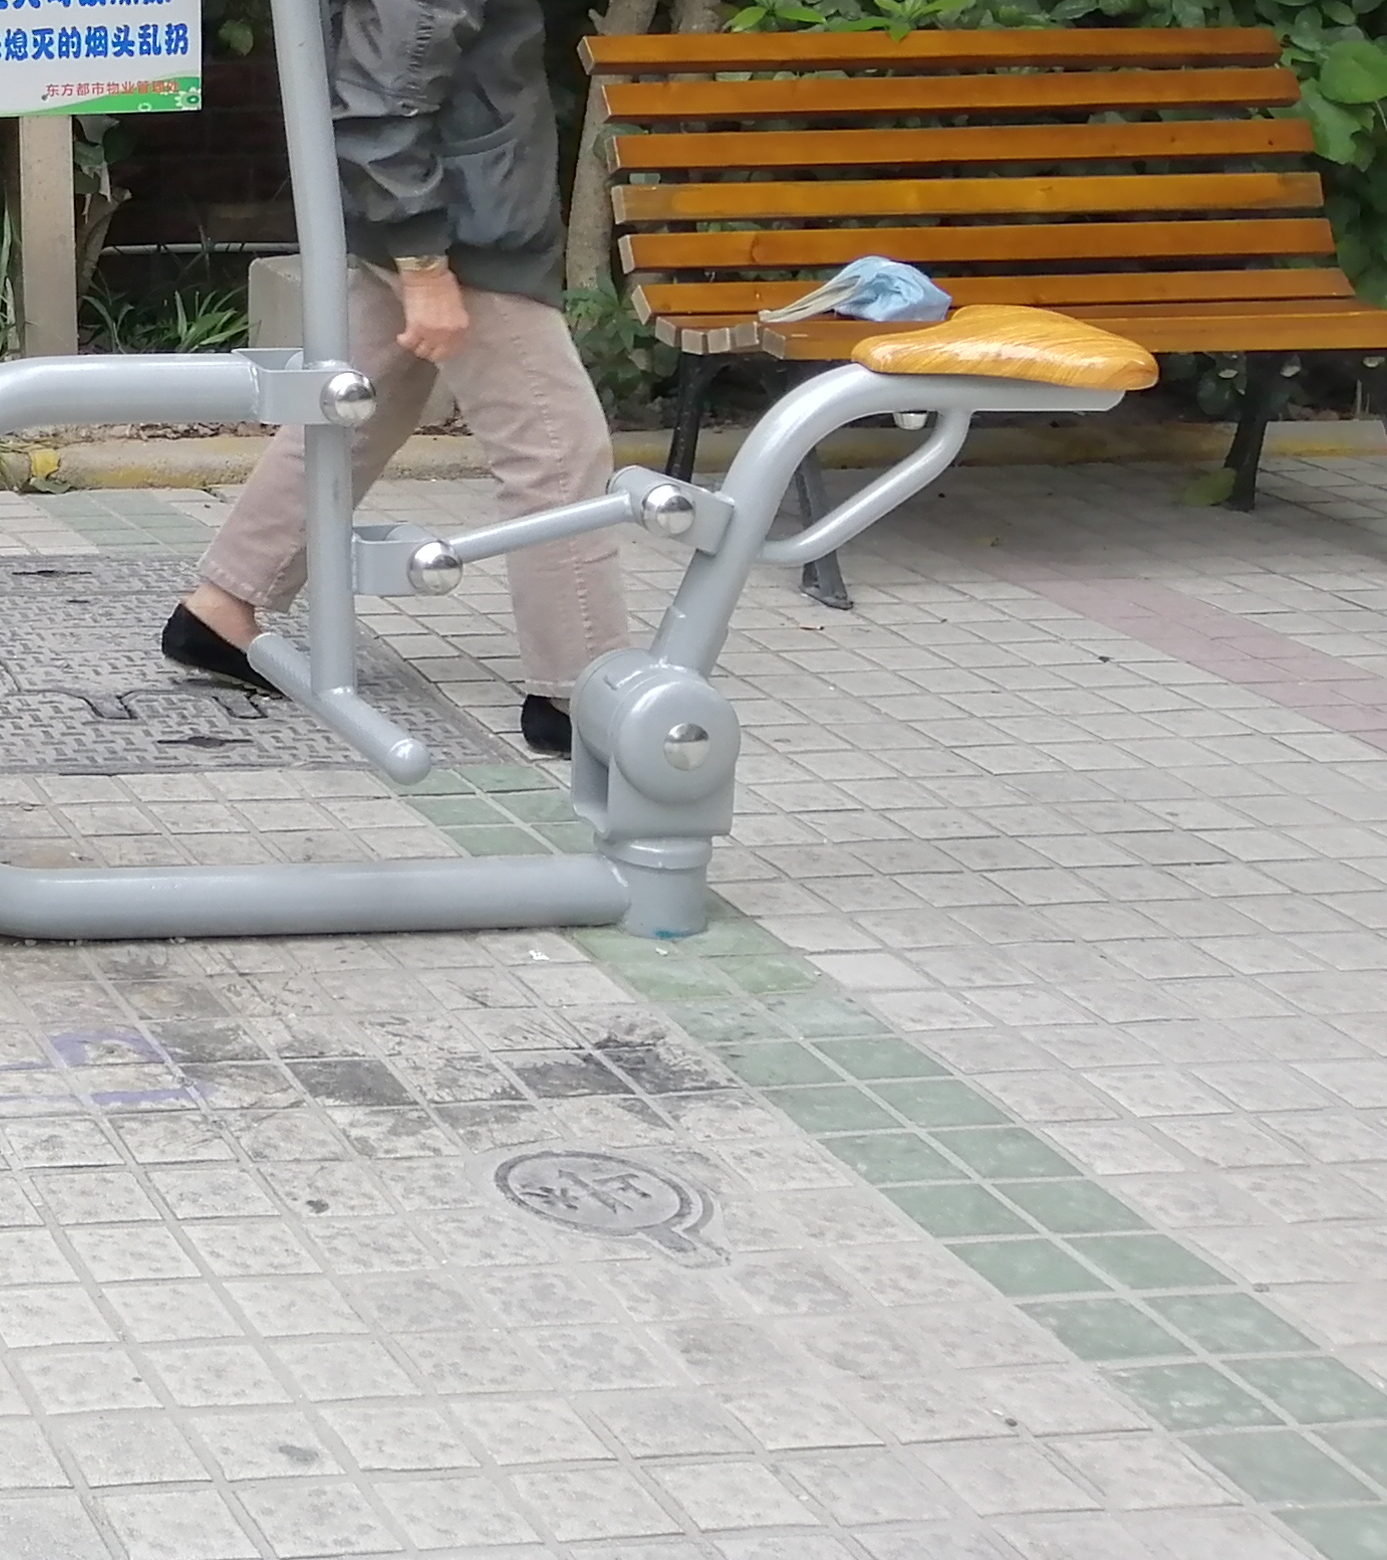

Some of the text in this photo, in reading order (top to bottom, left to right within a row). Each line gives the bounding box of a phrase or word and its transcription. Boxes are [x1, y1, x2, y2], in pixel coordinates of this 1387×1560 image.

[45, 80, 180, 98] 东方都市物业管理处
